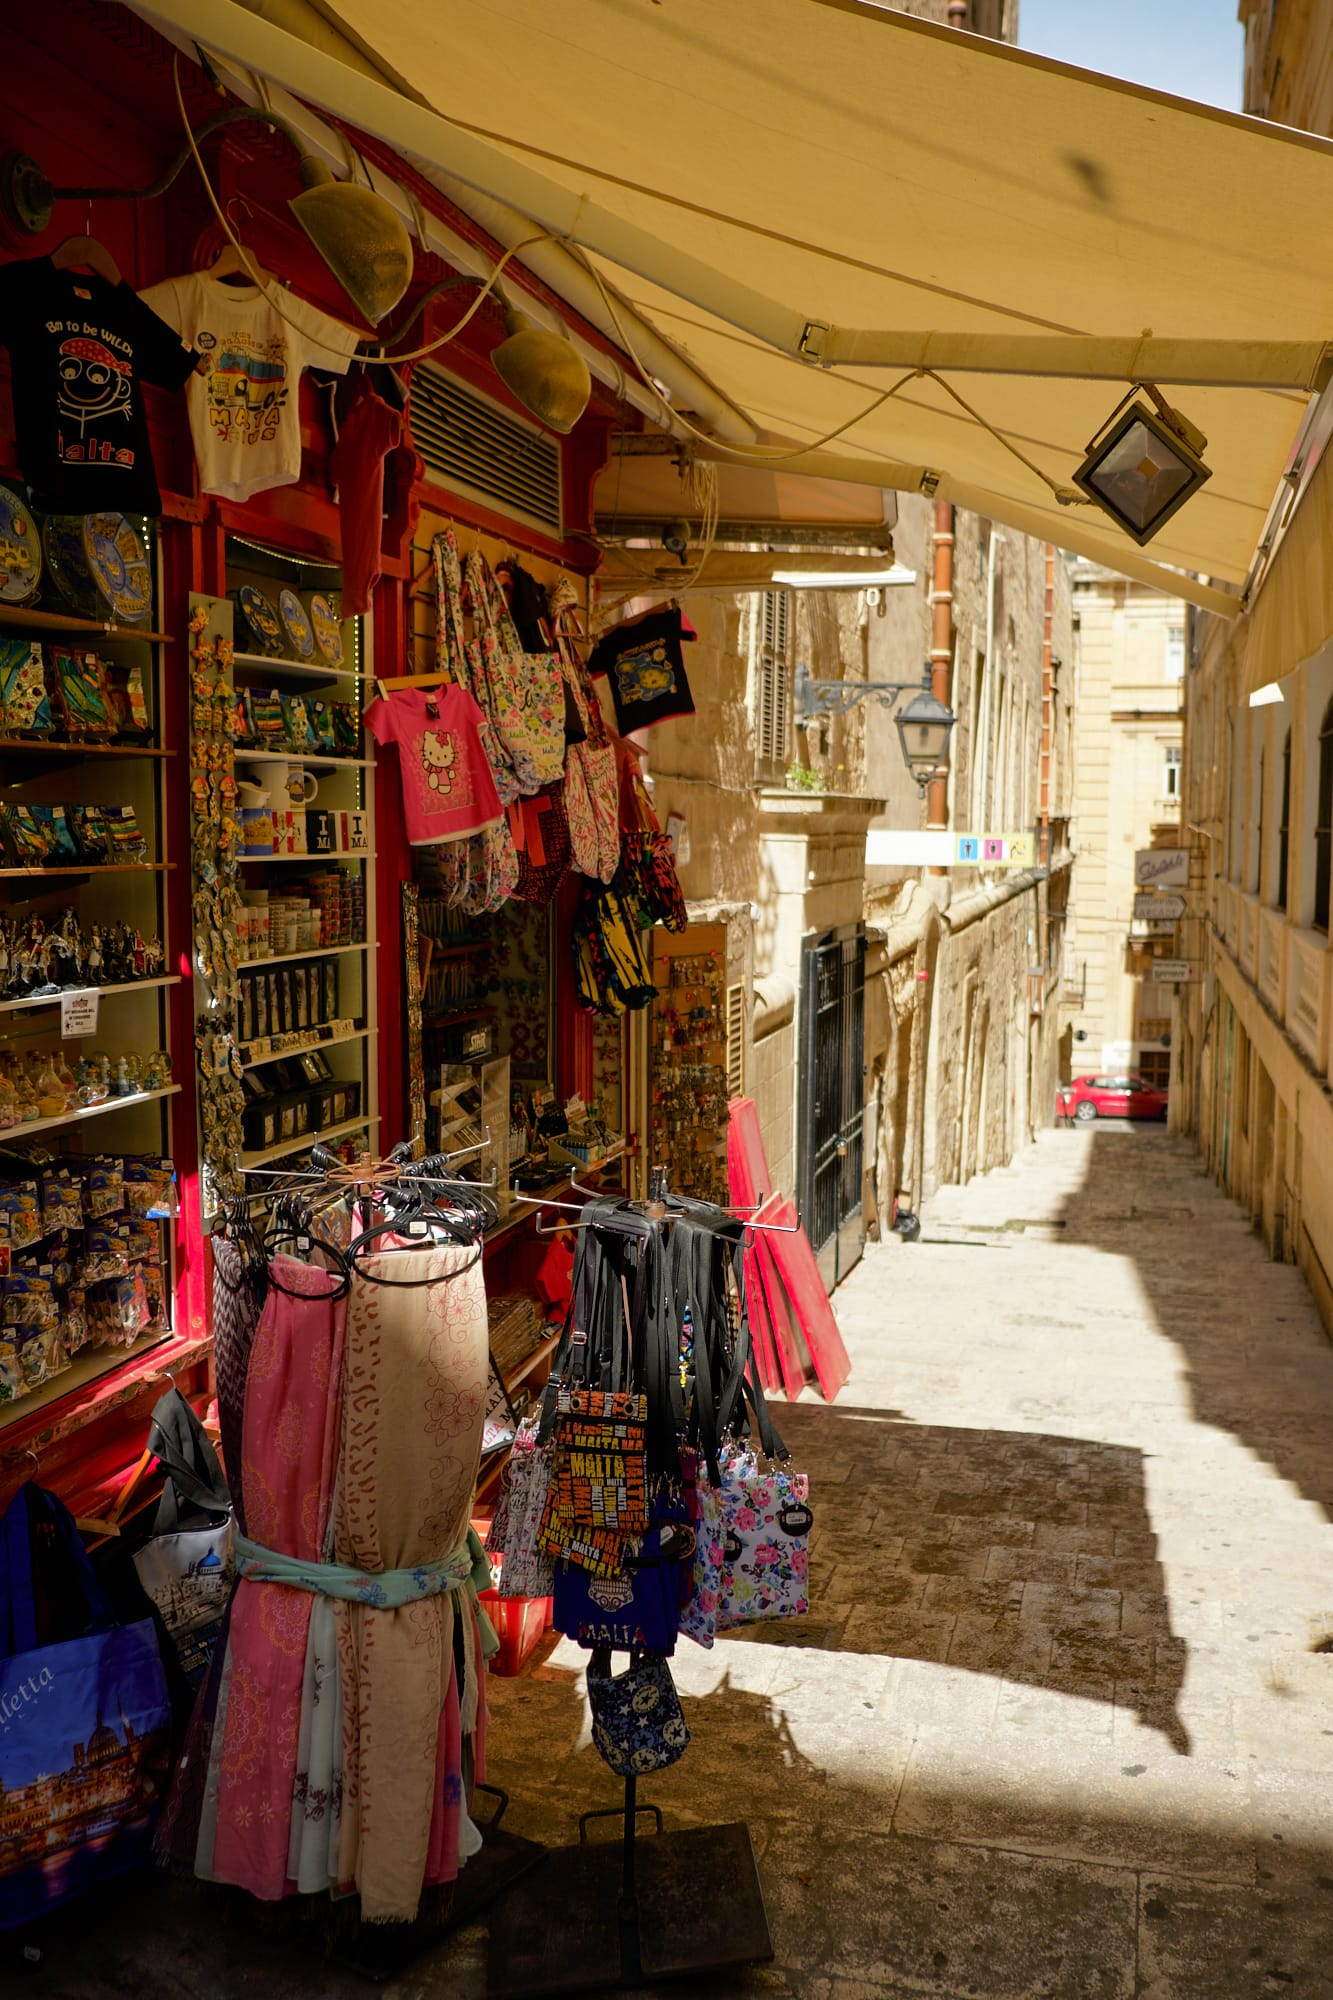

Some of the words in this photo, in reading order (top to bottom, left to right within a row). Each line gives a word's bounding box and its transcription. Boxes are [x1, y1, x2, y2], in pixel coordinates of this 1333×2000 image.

[66, 321, 80, 333] to
[83, 322, 98, 336] be
[353, 816, 362, 835] I
[570, 1452, 626, 1479] MALTA
[571, 1539, 601, 1561] MALTA
[578, 1619, 647, 1647] MALTA
